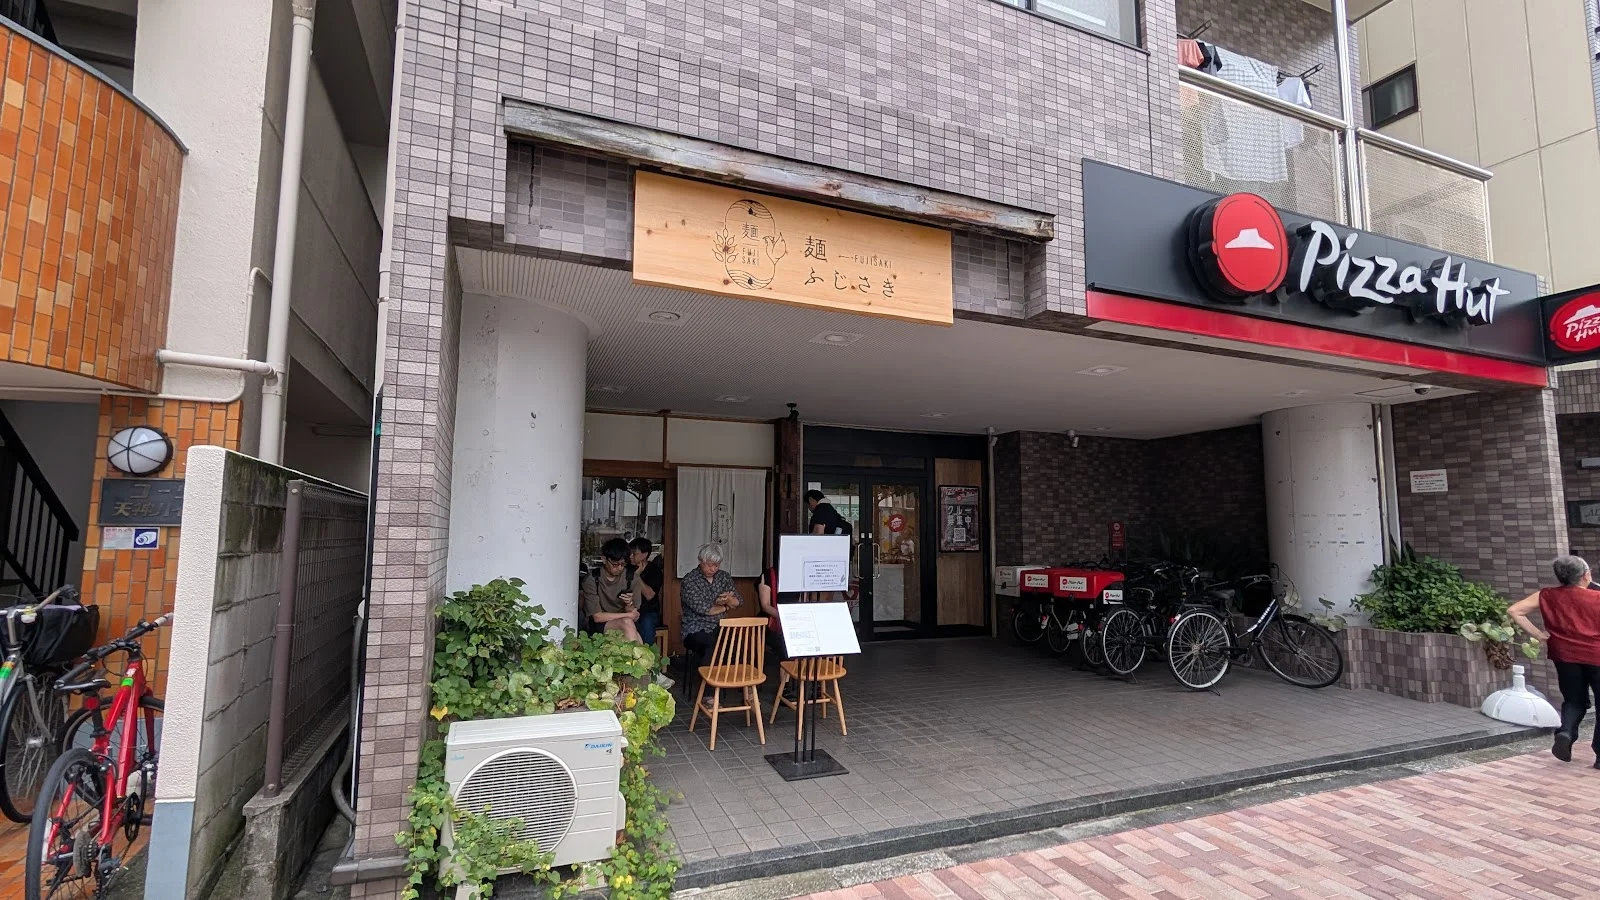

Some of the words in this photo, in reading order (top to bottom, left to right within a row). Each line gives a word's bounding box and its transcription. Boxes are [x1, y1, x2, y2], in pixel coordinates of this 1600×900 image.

[742, 221, 760, 241] 麺
[804, 235, 828, 262] 麺
[854, 254, 892, 269] FUJISAKI
[804, 266, 895, 298] ふじさき
[1300, 220, 1428, 304] Pizza
[1432, 255, 1512, 324] Hut
